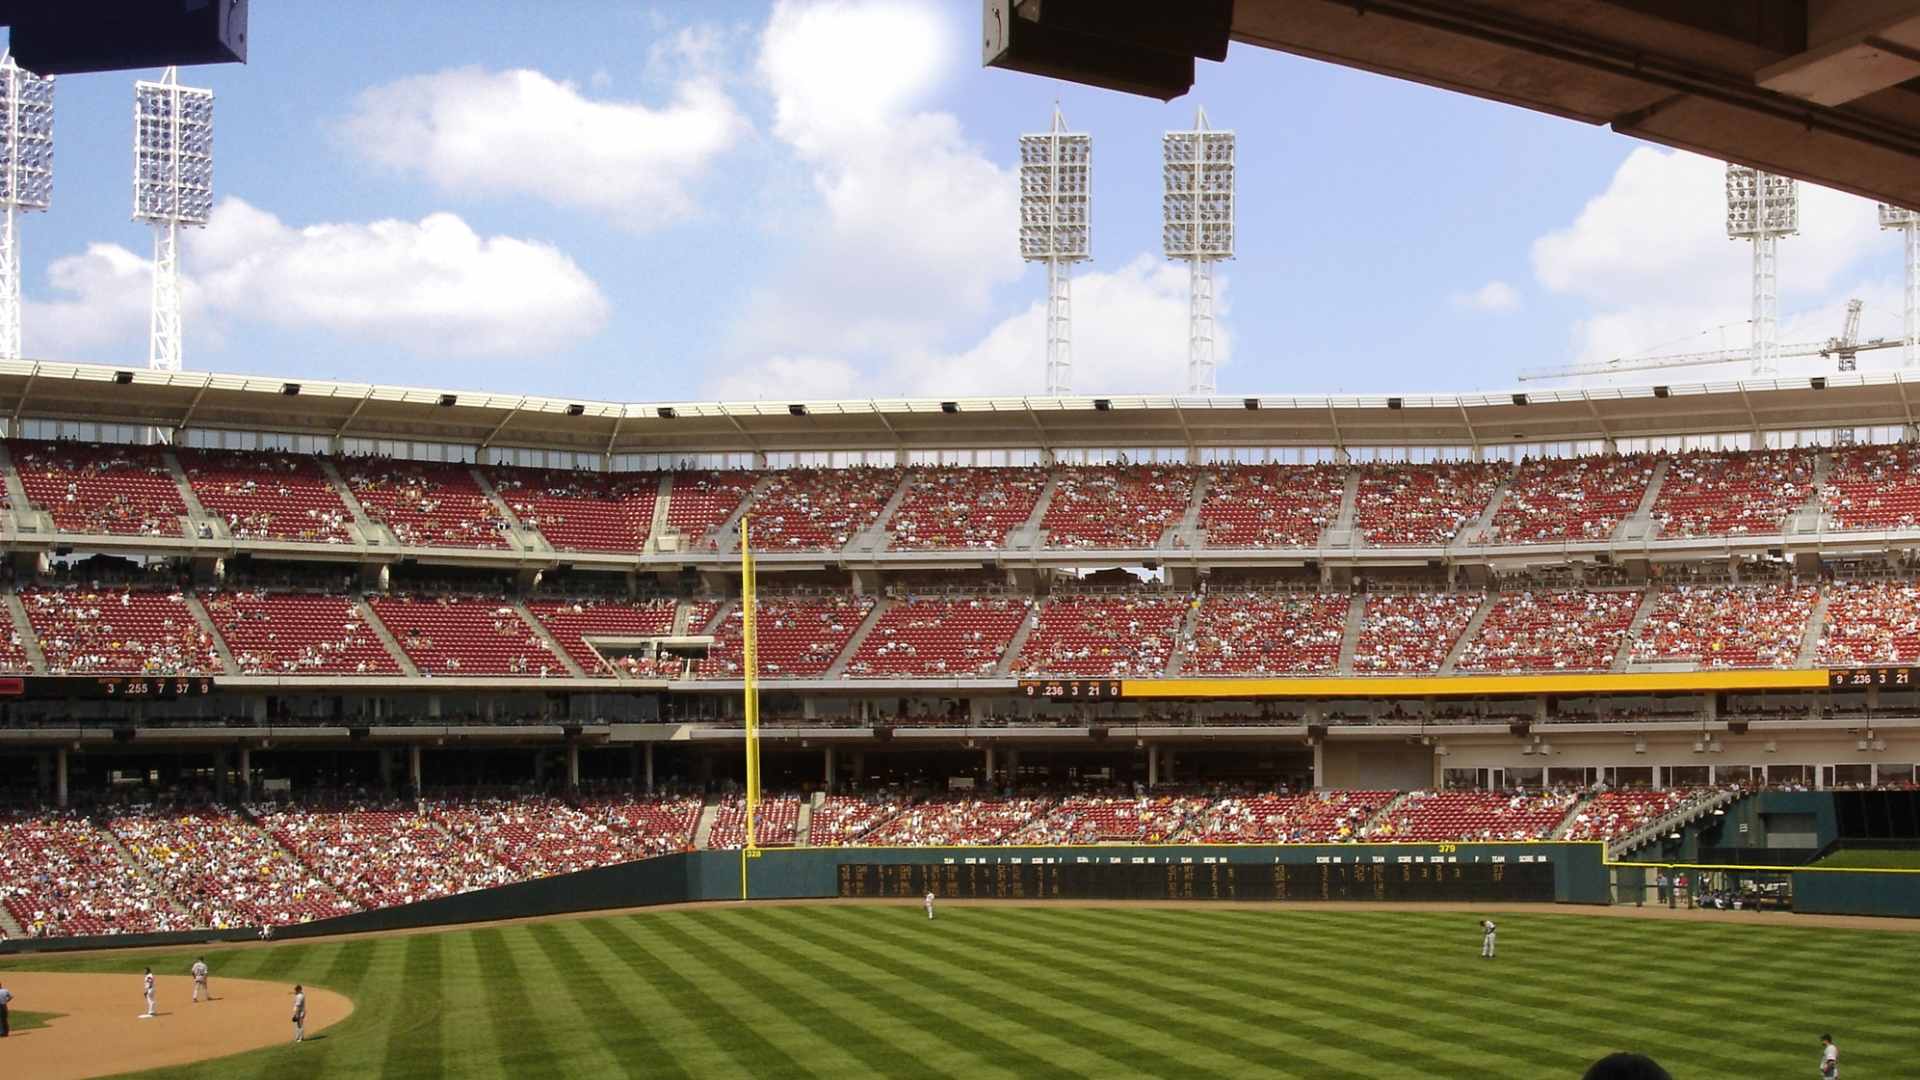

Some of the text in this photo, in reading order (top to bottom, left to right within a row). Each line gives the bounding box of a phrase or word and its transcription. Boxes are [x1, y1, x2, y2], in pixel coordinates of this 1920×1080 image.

[1836, 673, 1909, 684] 9 .236 3 21
[107, 683, 115, 693] 3
[157, 683, 165, 693] 7
[176, 683, 189, 693] 37
[201, 683, 208, 693] 9
[1027, 686, 1118, 696] 9 .236 3 21 0
[1439, 844, 1456, 853] 379
